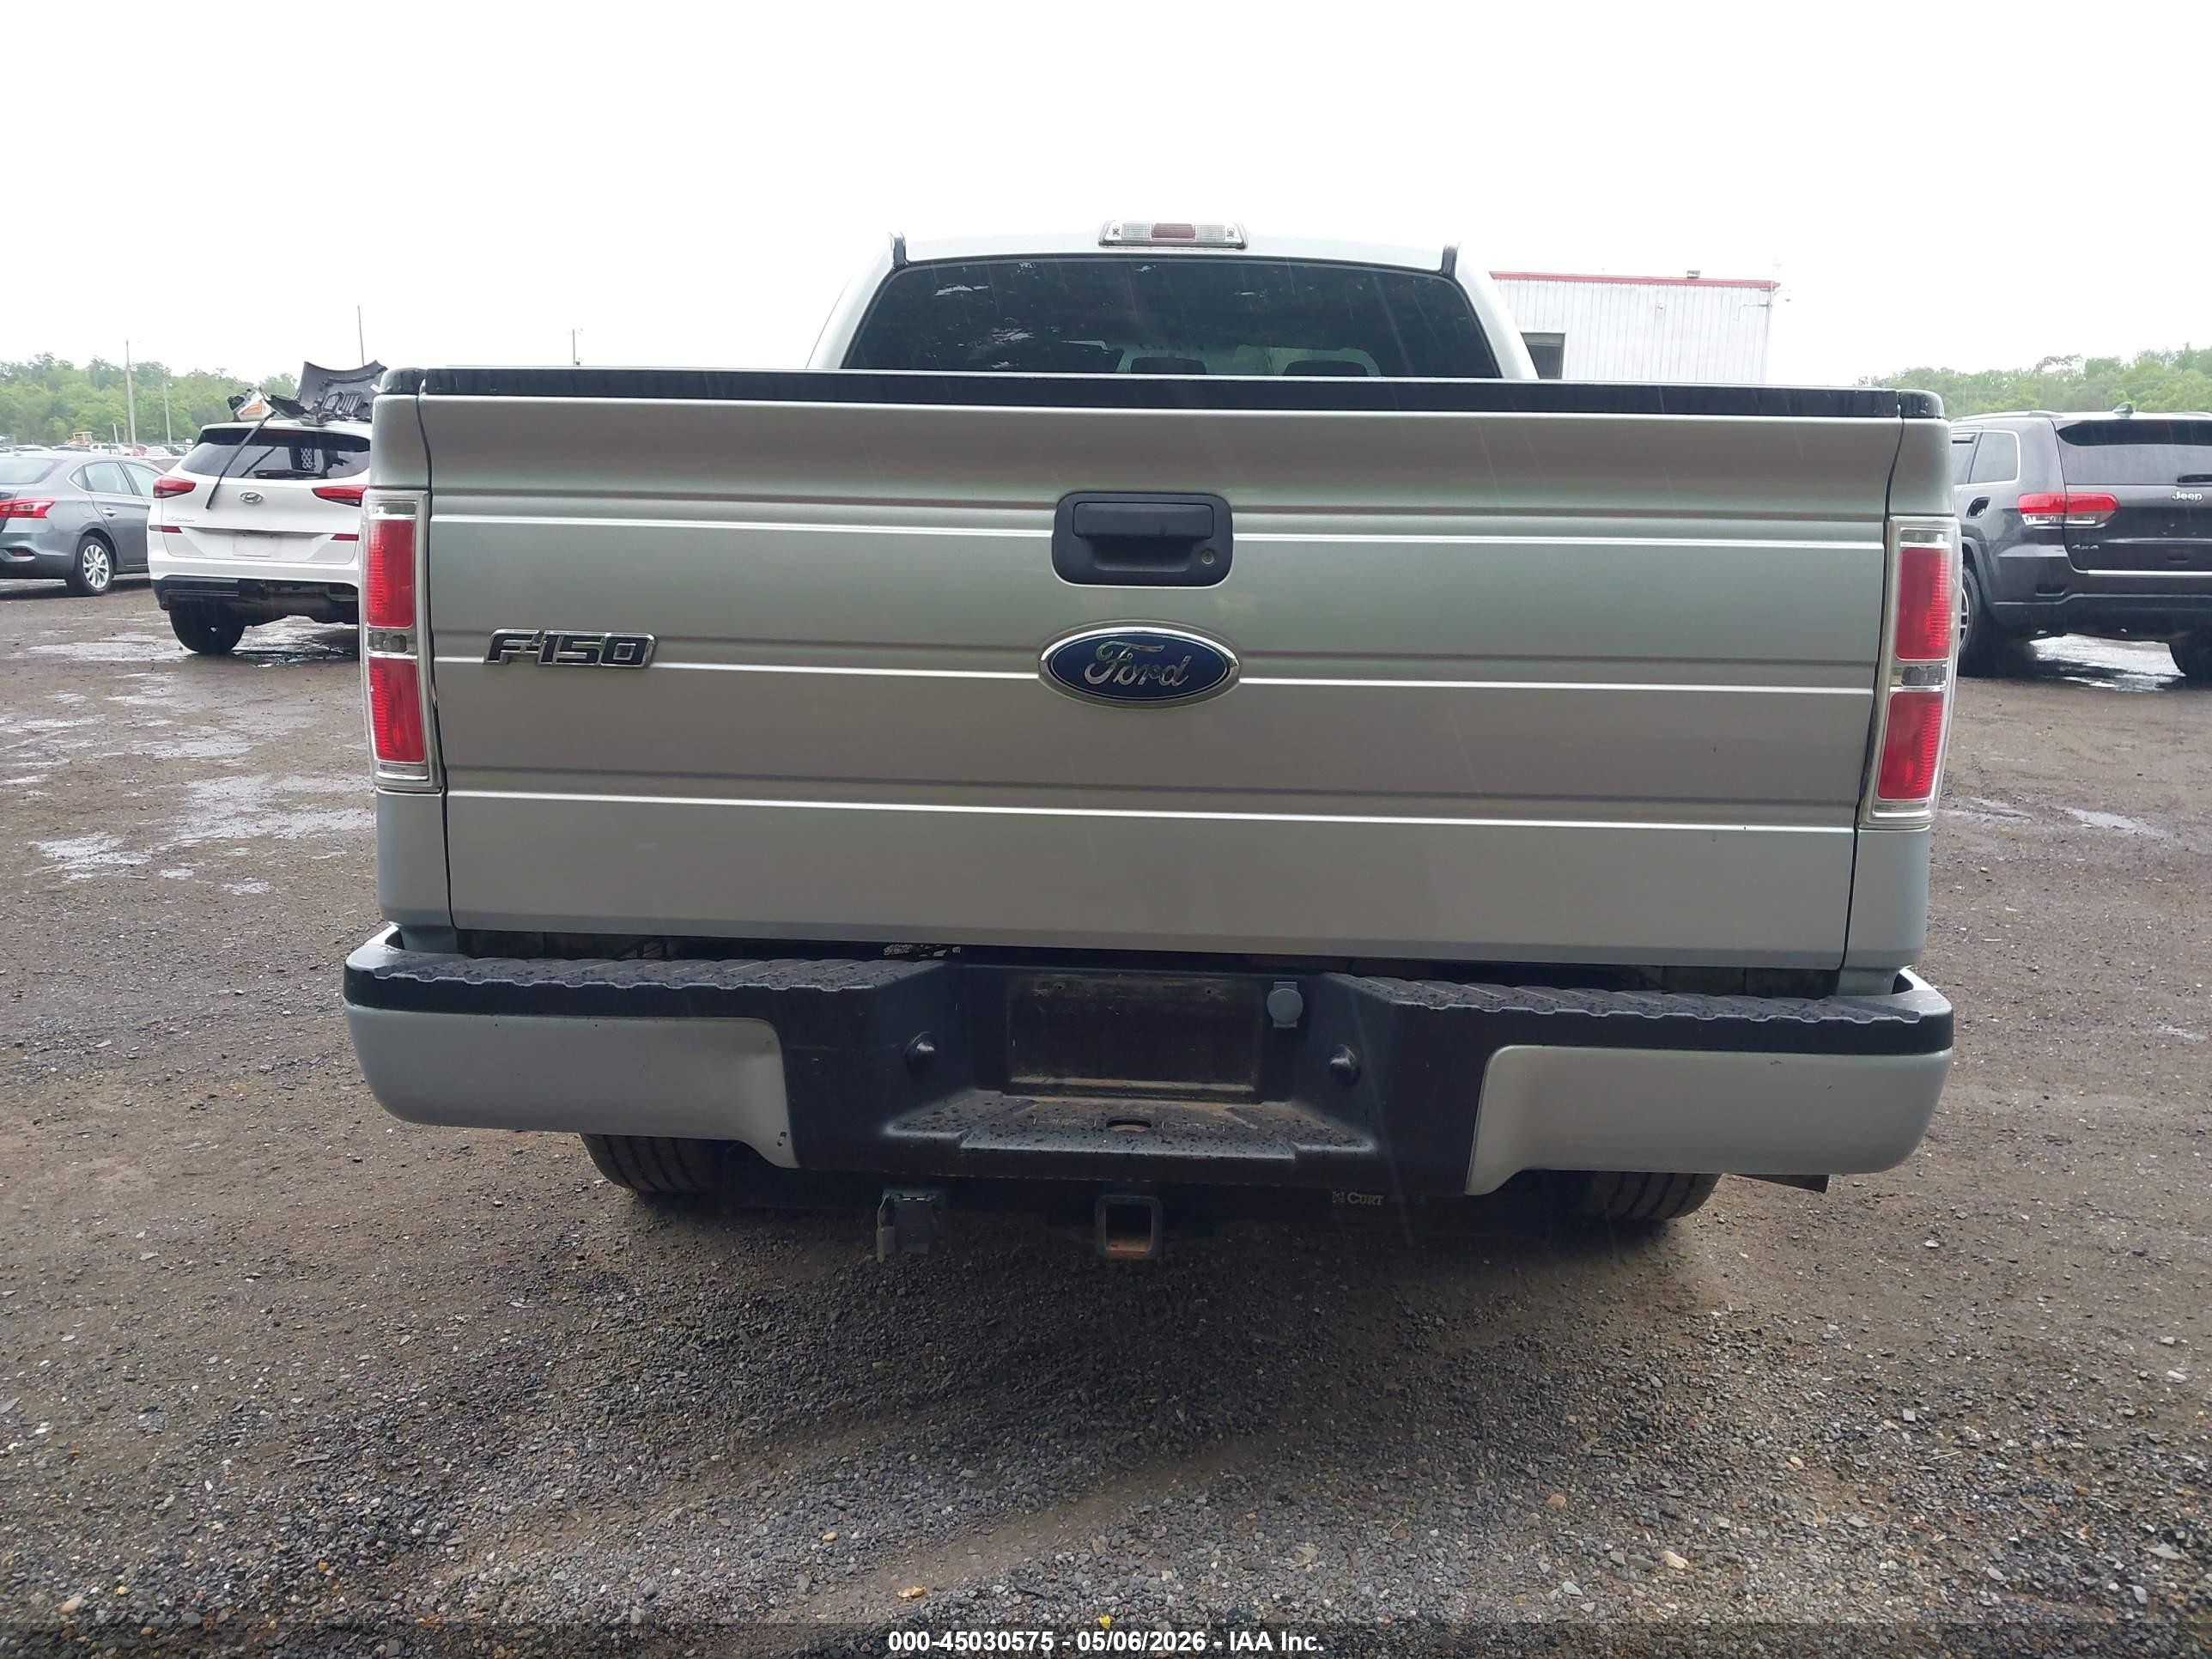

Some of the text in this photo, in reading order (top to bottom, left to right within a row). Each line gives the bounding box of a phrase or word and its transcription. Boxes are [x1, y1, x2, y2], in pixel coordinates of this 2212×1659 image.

[2171, 490, 2203, 501] Jeep
[485, 629, 656, 667] F-150
[1084, 641, 1192, 686] Ford
